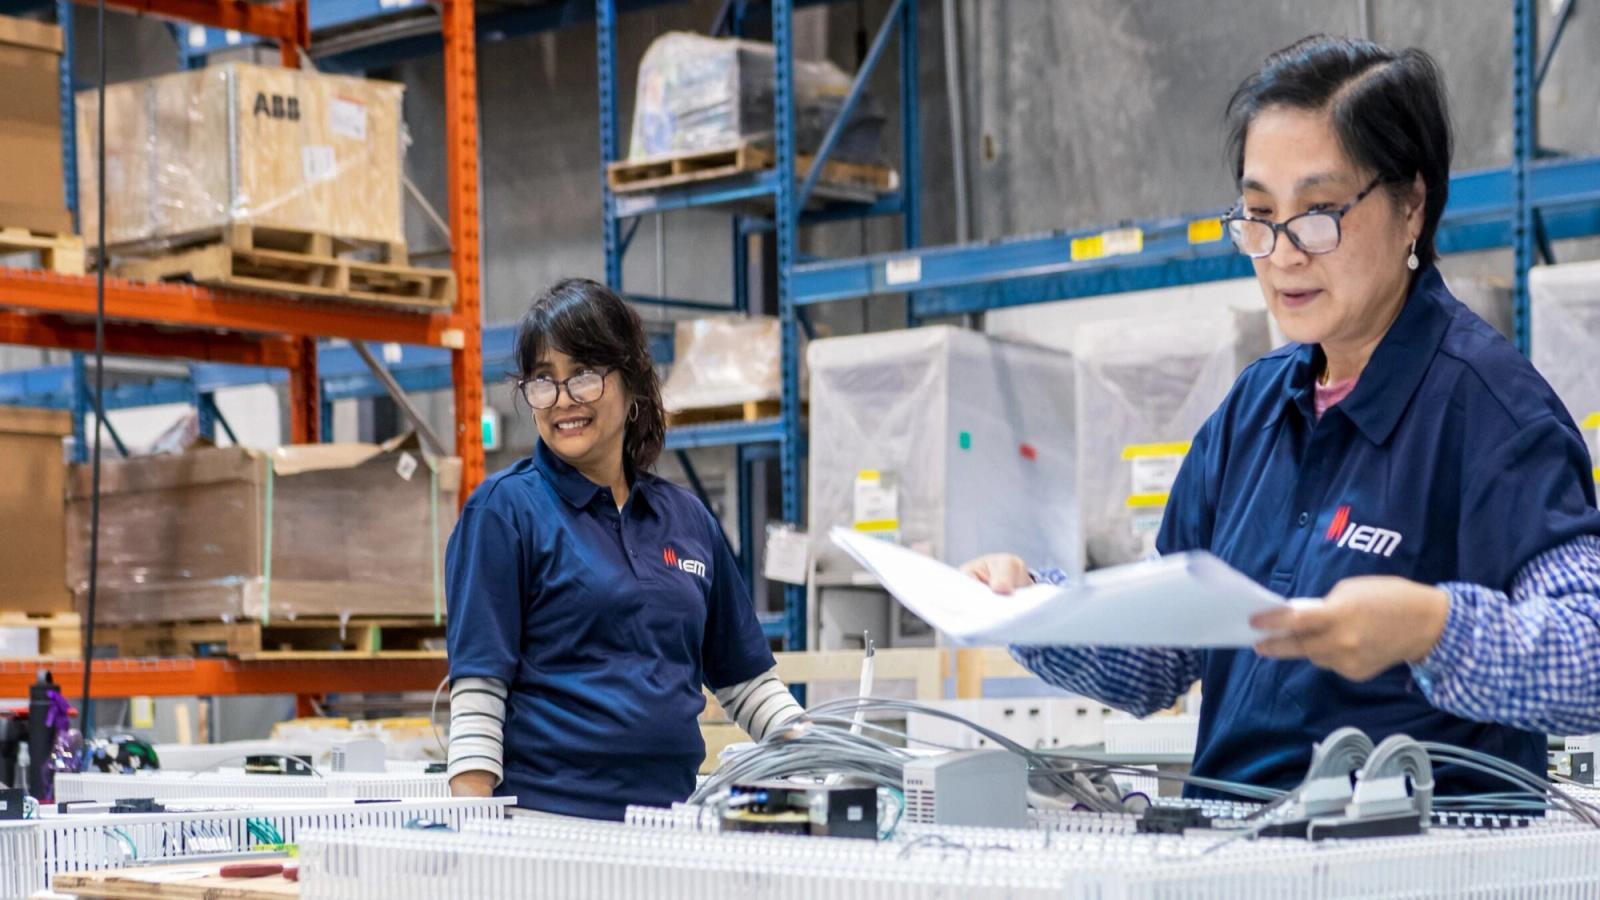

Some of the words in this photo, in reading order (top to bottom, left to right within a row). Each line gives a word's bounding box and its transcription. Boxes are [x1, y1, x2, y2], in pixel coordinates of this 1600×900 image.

[253, 91, 301, 121] ABB
[1337, 522, 1402, 557] IEM
[678, 558, 705, 578] IEM
